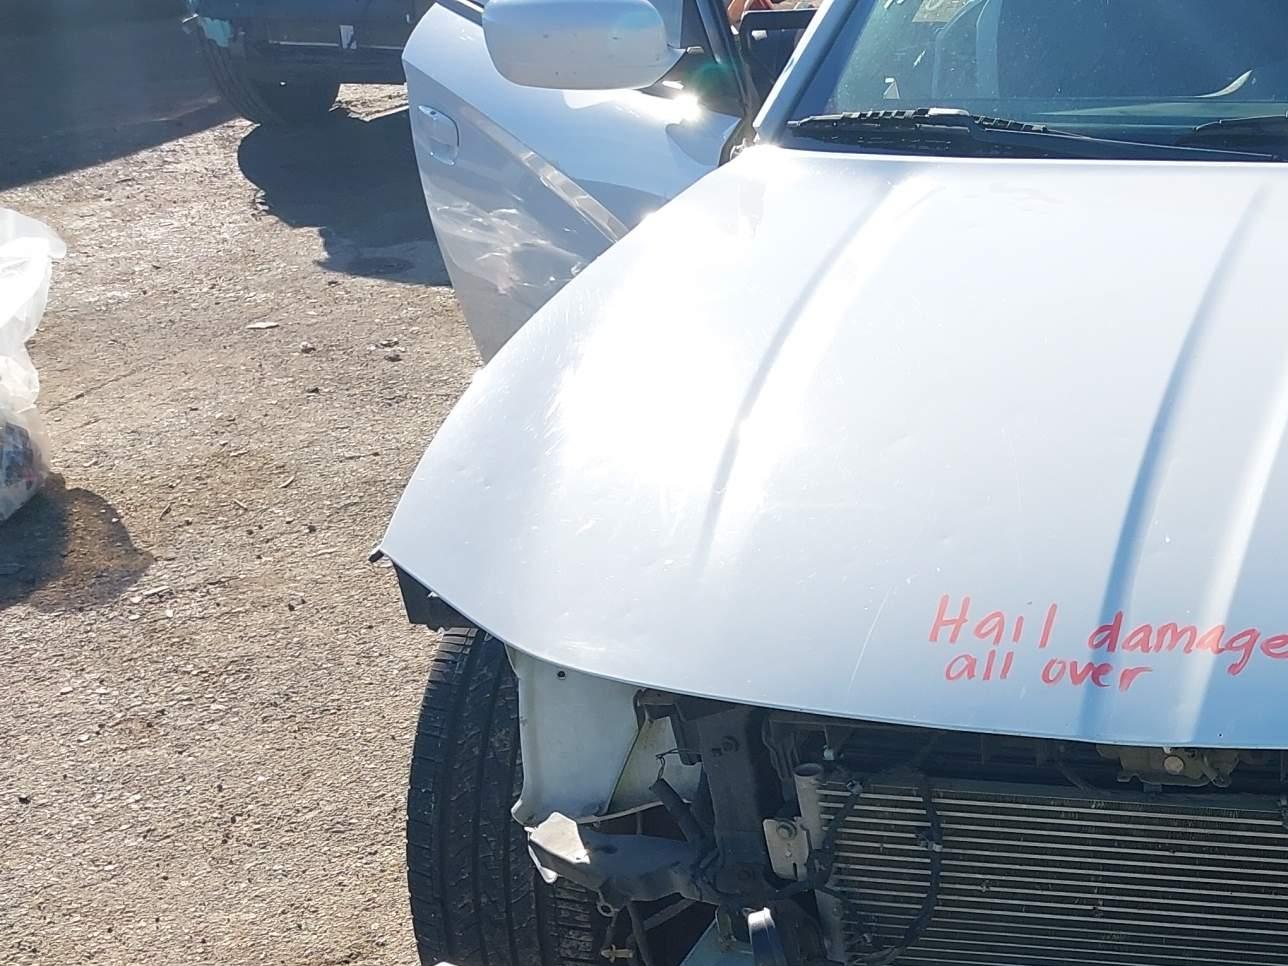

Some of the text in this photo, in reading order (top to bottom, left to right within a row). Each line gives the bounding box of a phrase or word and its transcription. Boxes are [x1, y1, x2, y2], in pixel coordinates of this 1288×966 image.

[928, 593, 1058, 649] Hail
[944, 649, 1153, 692] all over
